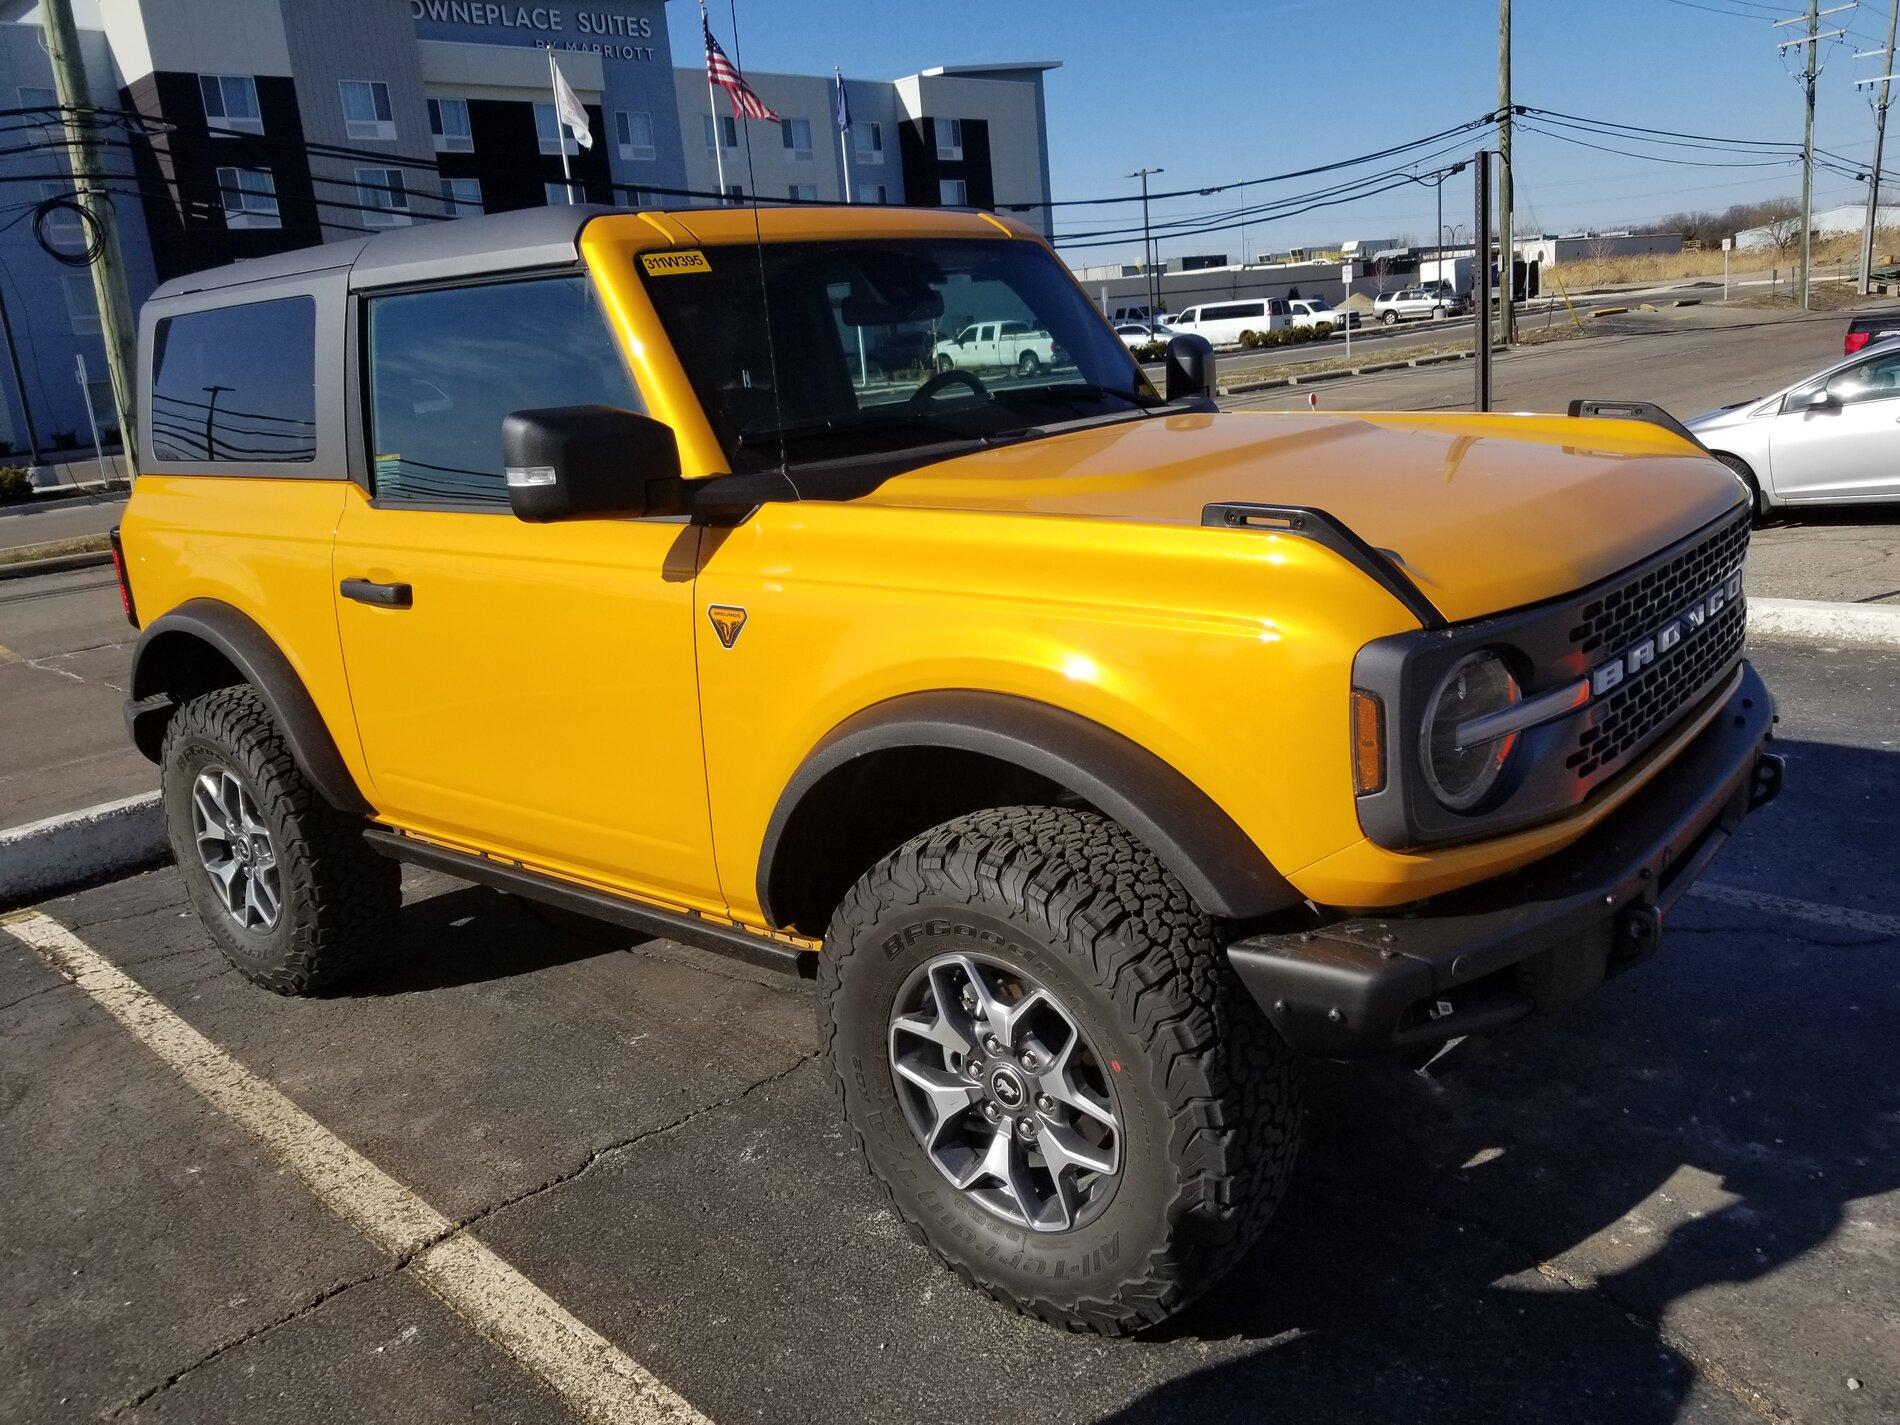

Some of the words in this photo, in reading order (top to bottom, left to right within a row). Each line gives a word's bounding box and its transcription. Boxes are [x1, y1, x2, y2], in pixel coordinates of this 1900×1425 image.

[577, 12, 652, 38] SUITES
[565, 41, 654, 60] MARRIOTT
[644, 255, 703, 269] 311W395
[1593, 574, 1741, 696] BRONCO
